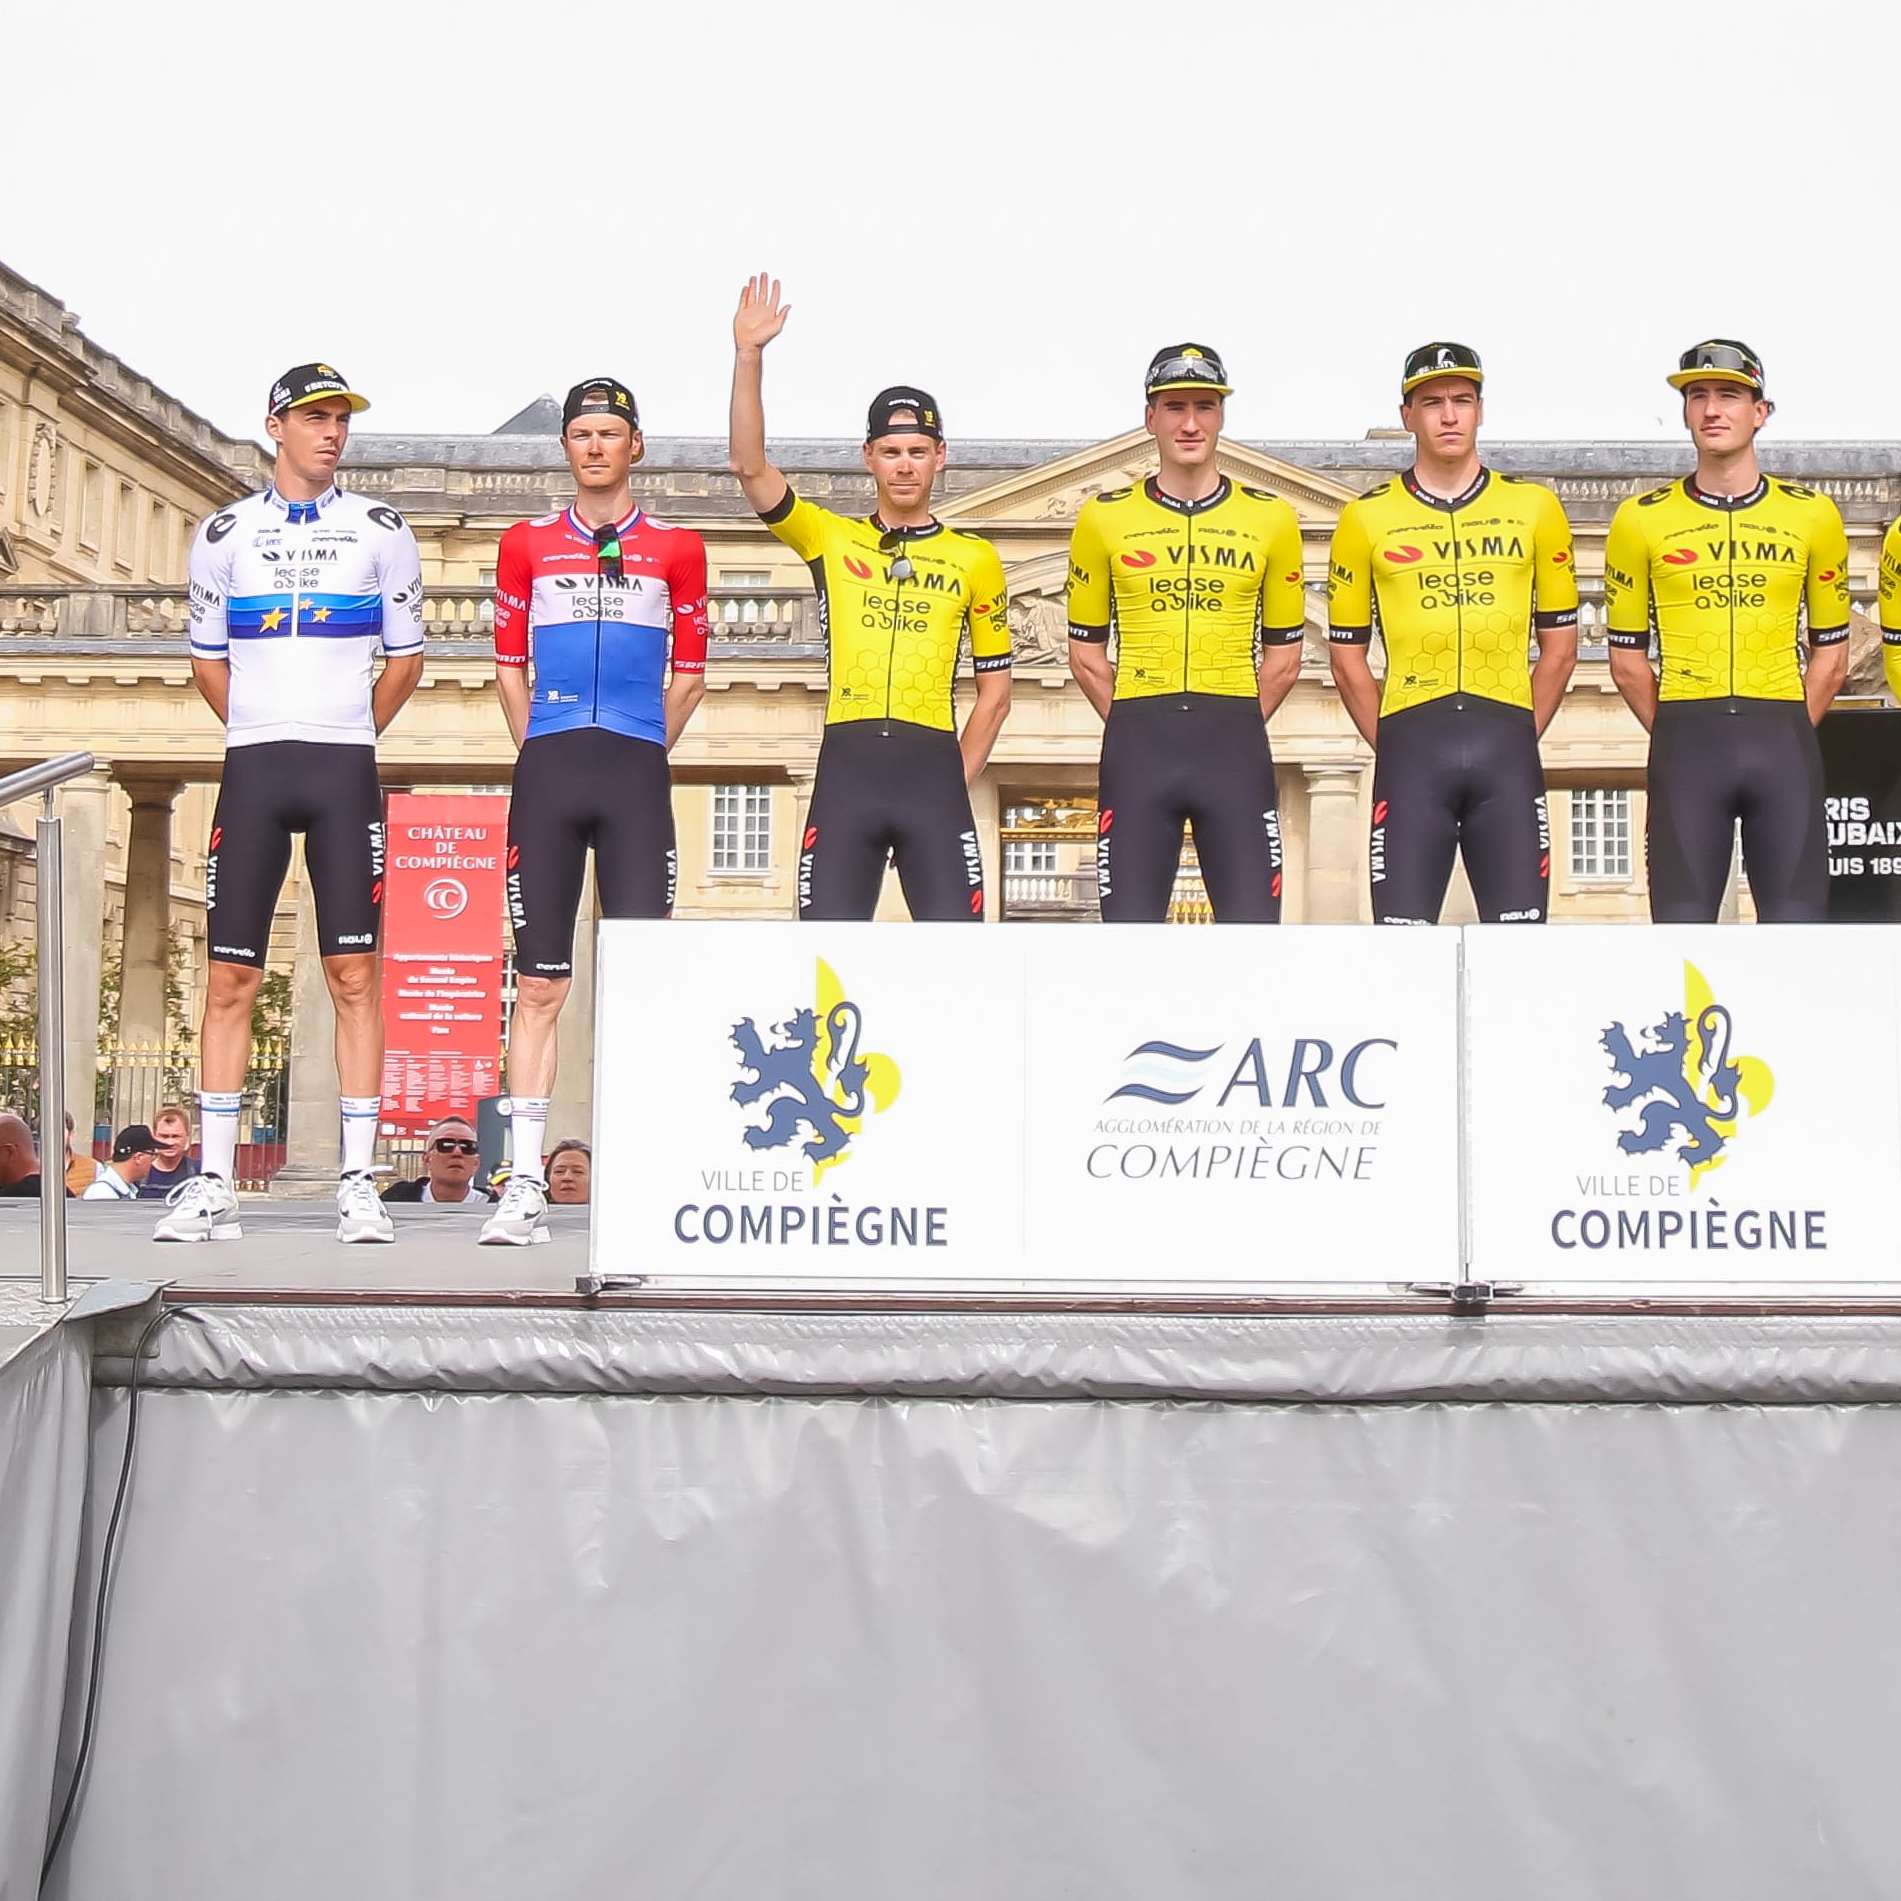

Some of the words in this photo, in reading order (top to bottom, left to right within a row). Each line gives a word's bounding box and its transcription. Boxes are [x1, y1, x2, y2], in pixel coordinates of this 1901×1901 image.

[286, 549, 338, 562] VISMA
[1166, 545, 1256, 573] VISMA
[1433, 535, 1525, 561] VISMA
[1707, 540, 1797, 563] VISMA
[1149, 576, 1225, 595] lease
[1417, 570, 1495, 591] lease
[1692, 573, 1767, 591] lease
[572, 595, 625, 607] lease
[862, 590, 931, 614] lease
[1824, 797, 1870, 821] RIS
[407, 825, 488, 841] CHÂTEAU
[1262, 809, 1282, 868] VISMA
[368, 822, 384, 877] VISMA
[435, 842, 457, 854] DE
[959, 831, 982, 886] VISMA
[1371, 827, 1387, 883] VISMA
[395, 855, 497, 870] COMPIÈGNE
[1098, 837, 1112, 898] VISMA
[1828, 857, 1865, 876] UIS
[207, 855, 218, 910] VISMA
[799, 853, 814, 909] VISMA
[507, 873, 528, 930] VISMA
[1215, 1037, 1398, 1110] ARC
[1093, 1116, 1233, 1134] AGGLOMÉRATION
[1240, 1120, 1261, 1134] DE
[1267, 1120, 1286, 1135] LA
[1293, 1117, 1354, 1135] RÉGION
[1361, 1120, 1382, 1135] DE
[1086, 1136, 1378, 1180] COMPIÈGNE
[701, 1169, 766, 1192] VILLE
[773, 1170, 805, 1192] DE
[1575, 1175, 1641, 1196] VILLE
[1649, 1176, 1681, 1196] DE
[674, 1194, 949, 1247] COMPIÈGNE
[1551, 1197, 1828, 1250] COMPIÈGNE
